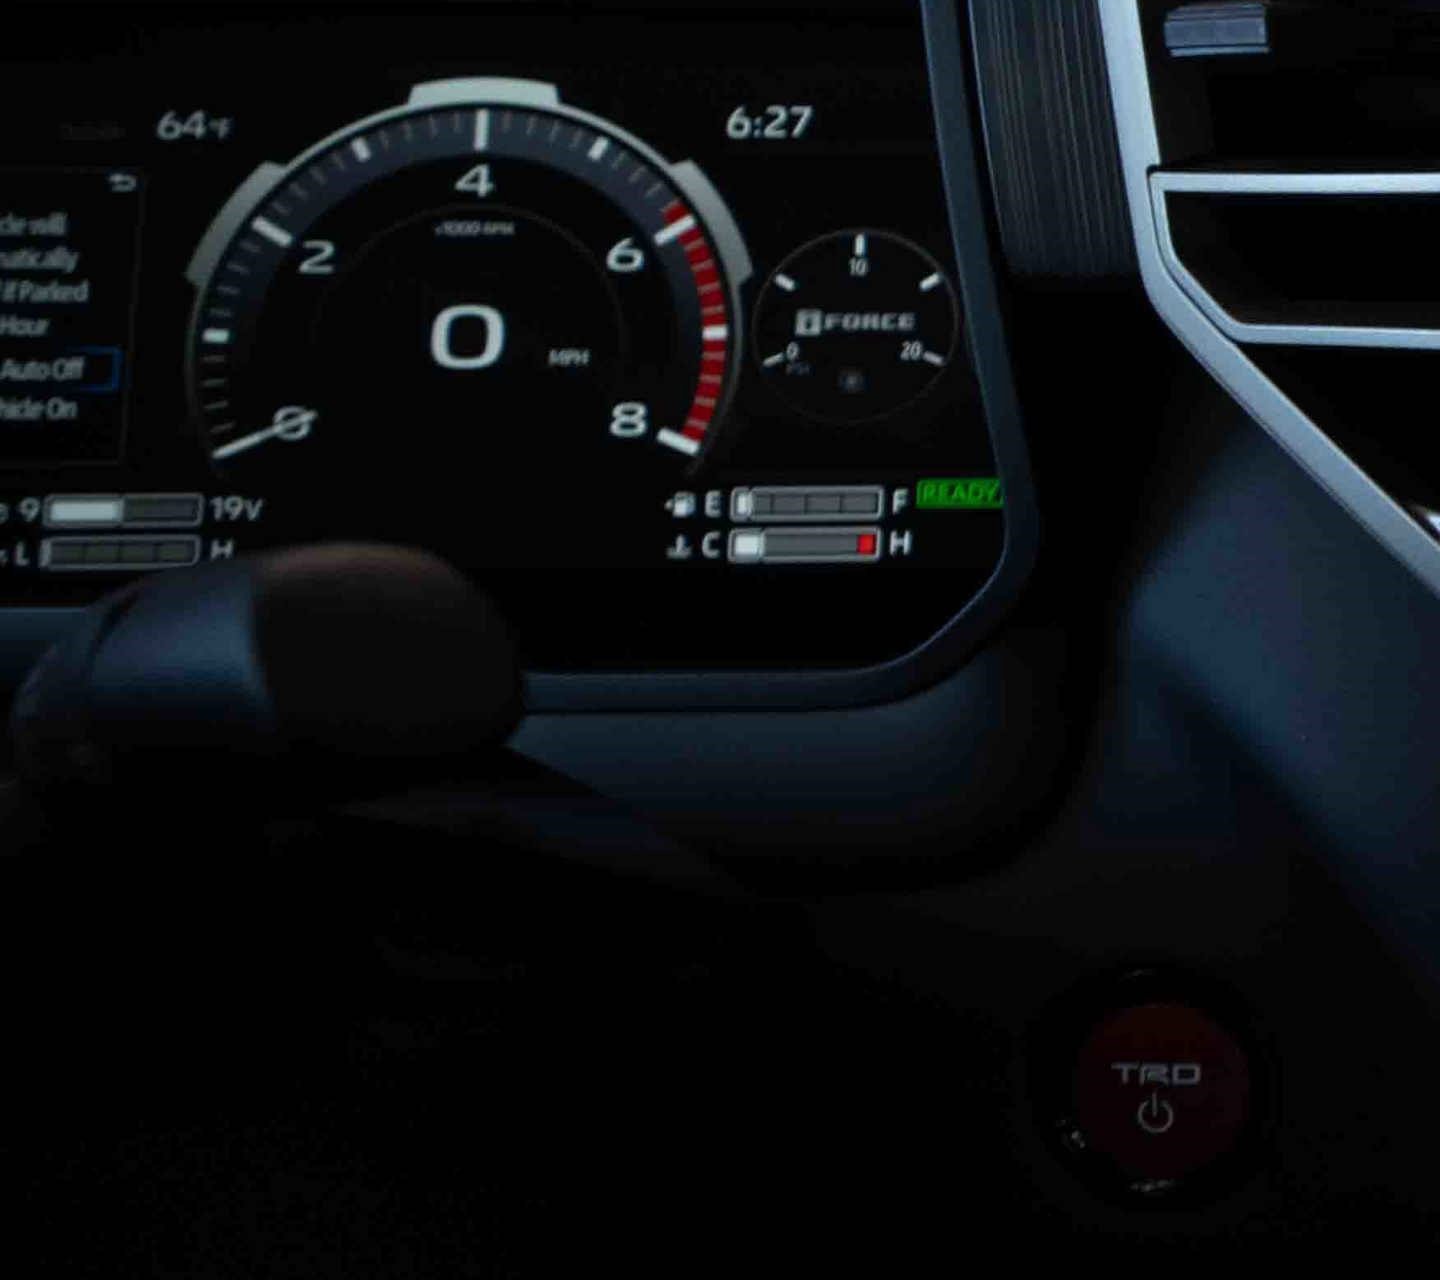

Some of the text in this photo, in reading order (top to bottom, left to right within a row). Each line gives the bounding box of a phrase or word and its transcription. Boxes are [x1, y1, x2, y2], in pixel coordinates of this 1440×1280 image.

[725, 104, 815, 140] 6:27
[454, 164, 494, 198] 4
[298, 238, 336, 275] 2
[605, 236, 645, 272] 6
[849, 257, 868, 277] 10
[19, 278, 90, 303] Parked
[431, 304, 504, 369] 0
[900, 340, 923, 361] 20
[52, 356, 87, 380] Off
[47, 395, 78, 419] On
[609, 402, 648, 437] 8
[703, 488, 723, 517] E
[891, 488, 910, 515] F
[915, 478, 999, 508] READY
[19, 495, 40, 523] 9
[15, 538, 32, 566] L
[702, 529, 722, 558] C
[889, 529, 912, 556] H
[1110, 1060, 1203, 1087] TRD
